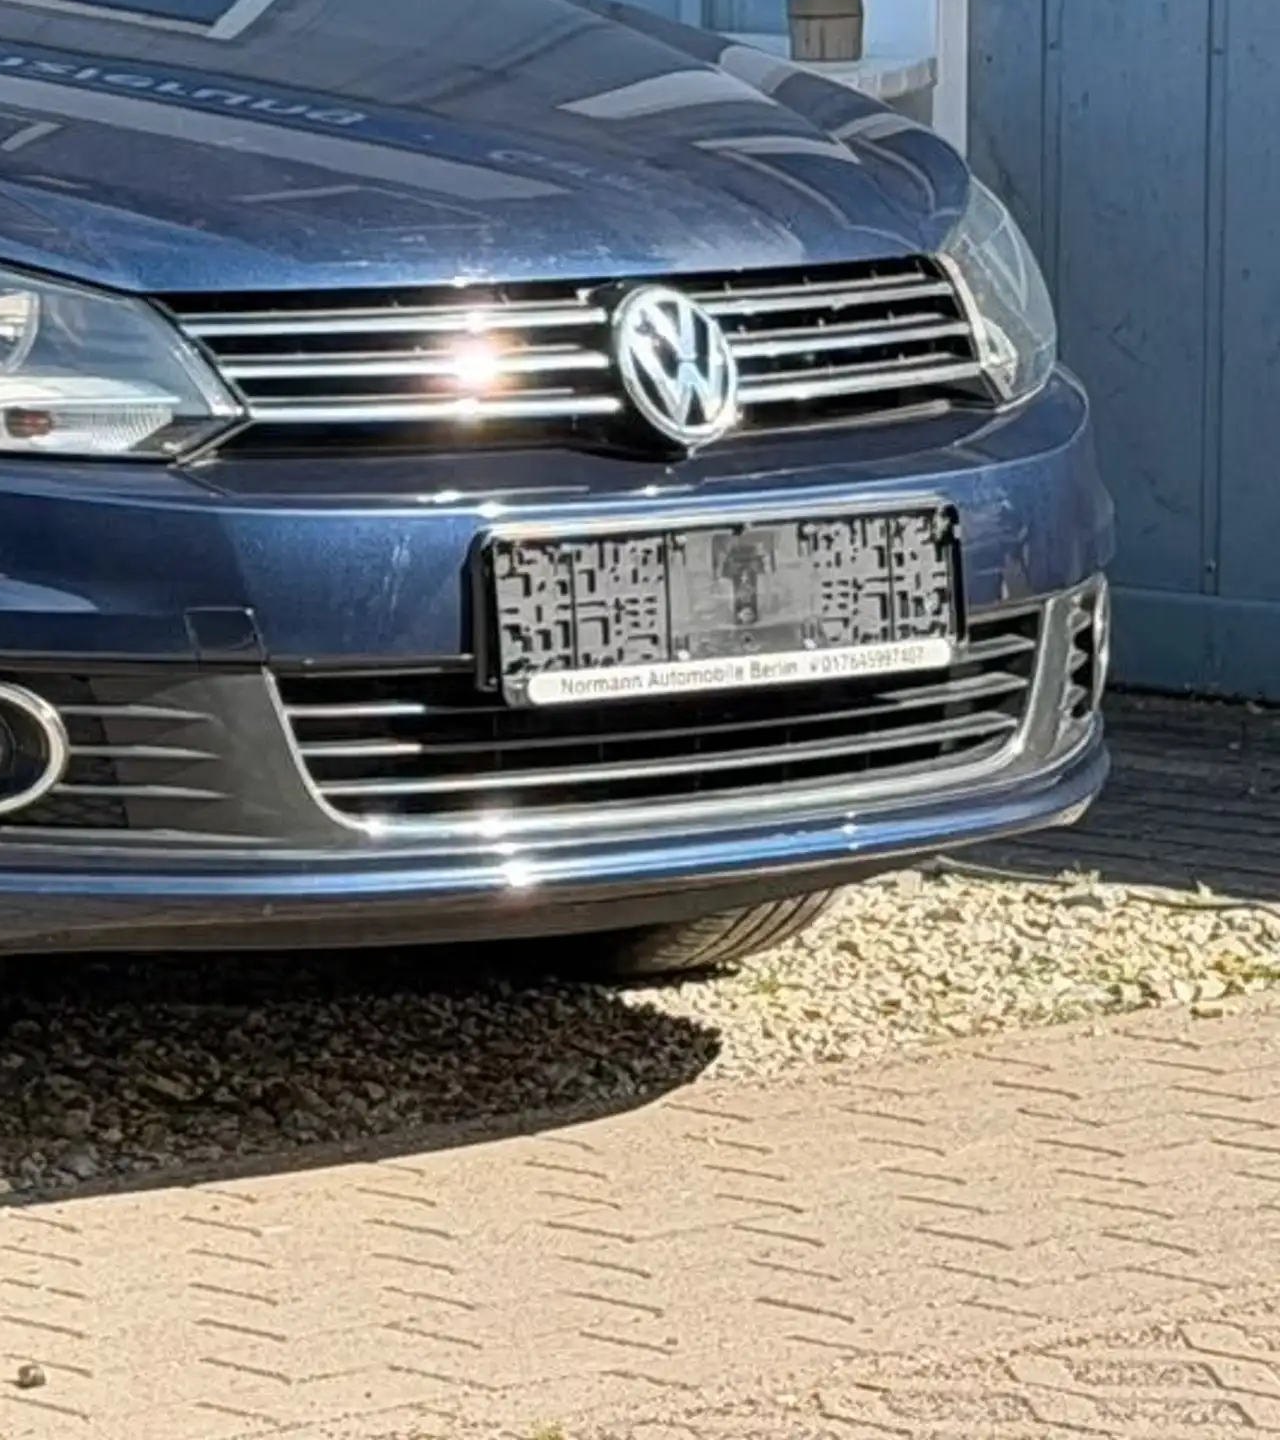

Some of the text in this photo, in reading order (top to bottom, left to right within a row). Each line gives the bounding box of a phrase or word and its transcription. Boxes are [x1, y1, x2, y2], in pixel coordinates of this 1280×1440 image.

[560, 672, 643, 695] Normann
[647, 663, 744, 688] Automobile
[749, 659, 798, 679] Berlin
